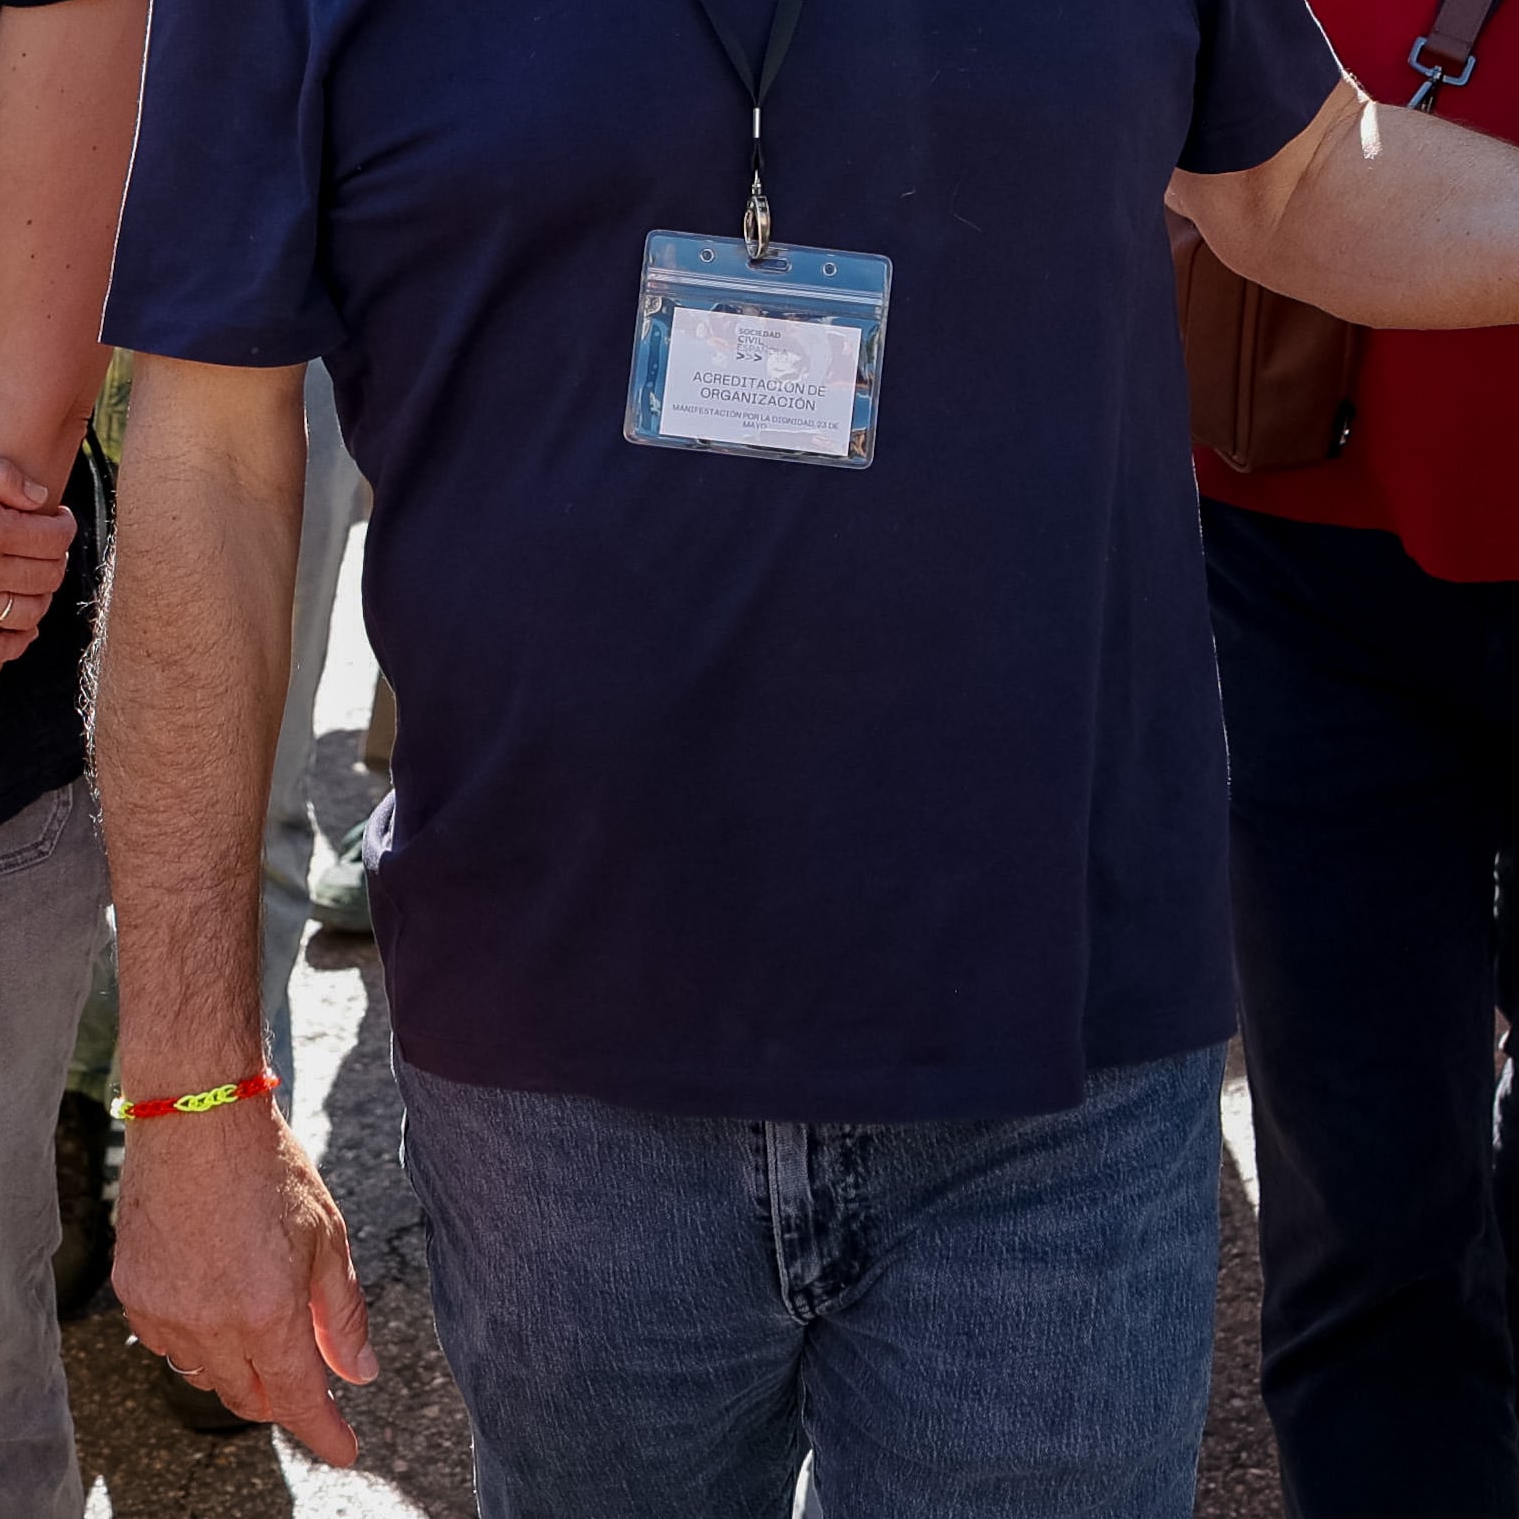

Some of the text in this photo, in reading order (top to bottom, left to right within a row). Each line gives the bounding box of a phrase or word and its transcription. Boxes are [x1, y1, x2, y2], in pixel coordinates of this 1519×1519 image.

[737, 335, 764, 346] CIVIL
[739, 328, 781, 339] SOCIEDAD
[692, 371, 828, 397] ACREDITACIÓN DE
[700, 387, 816, 411] ORGANIZACIÓN
